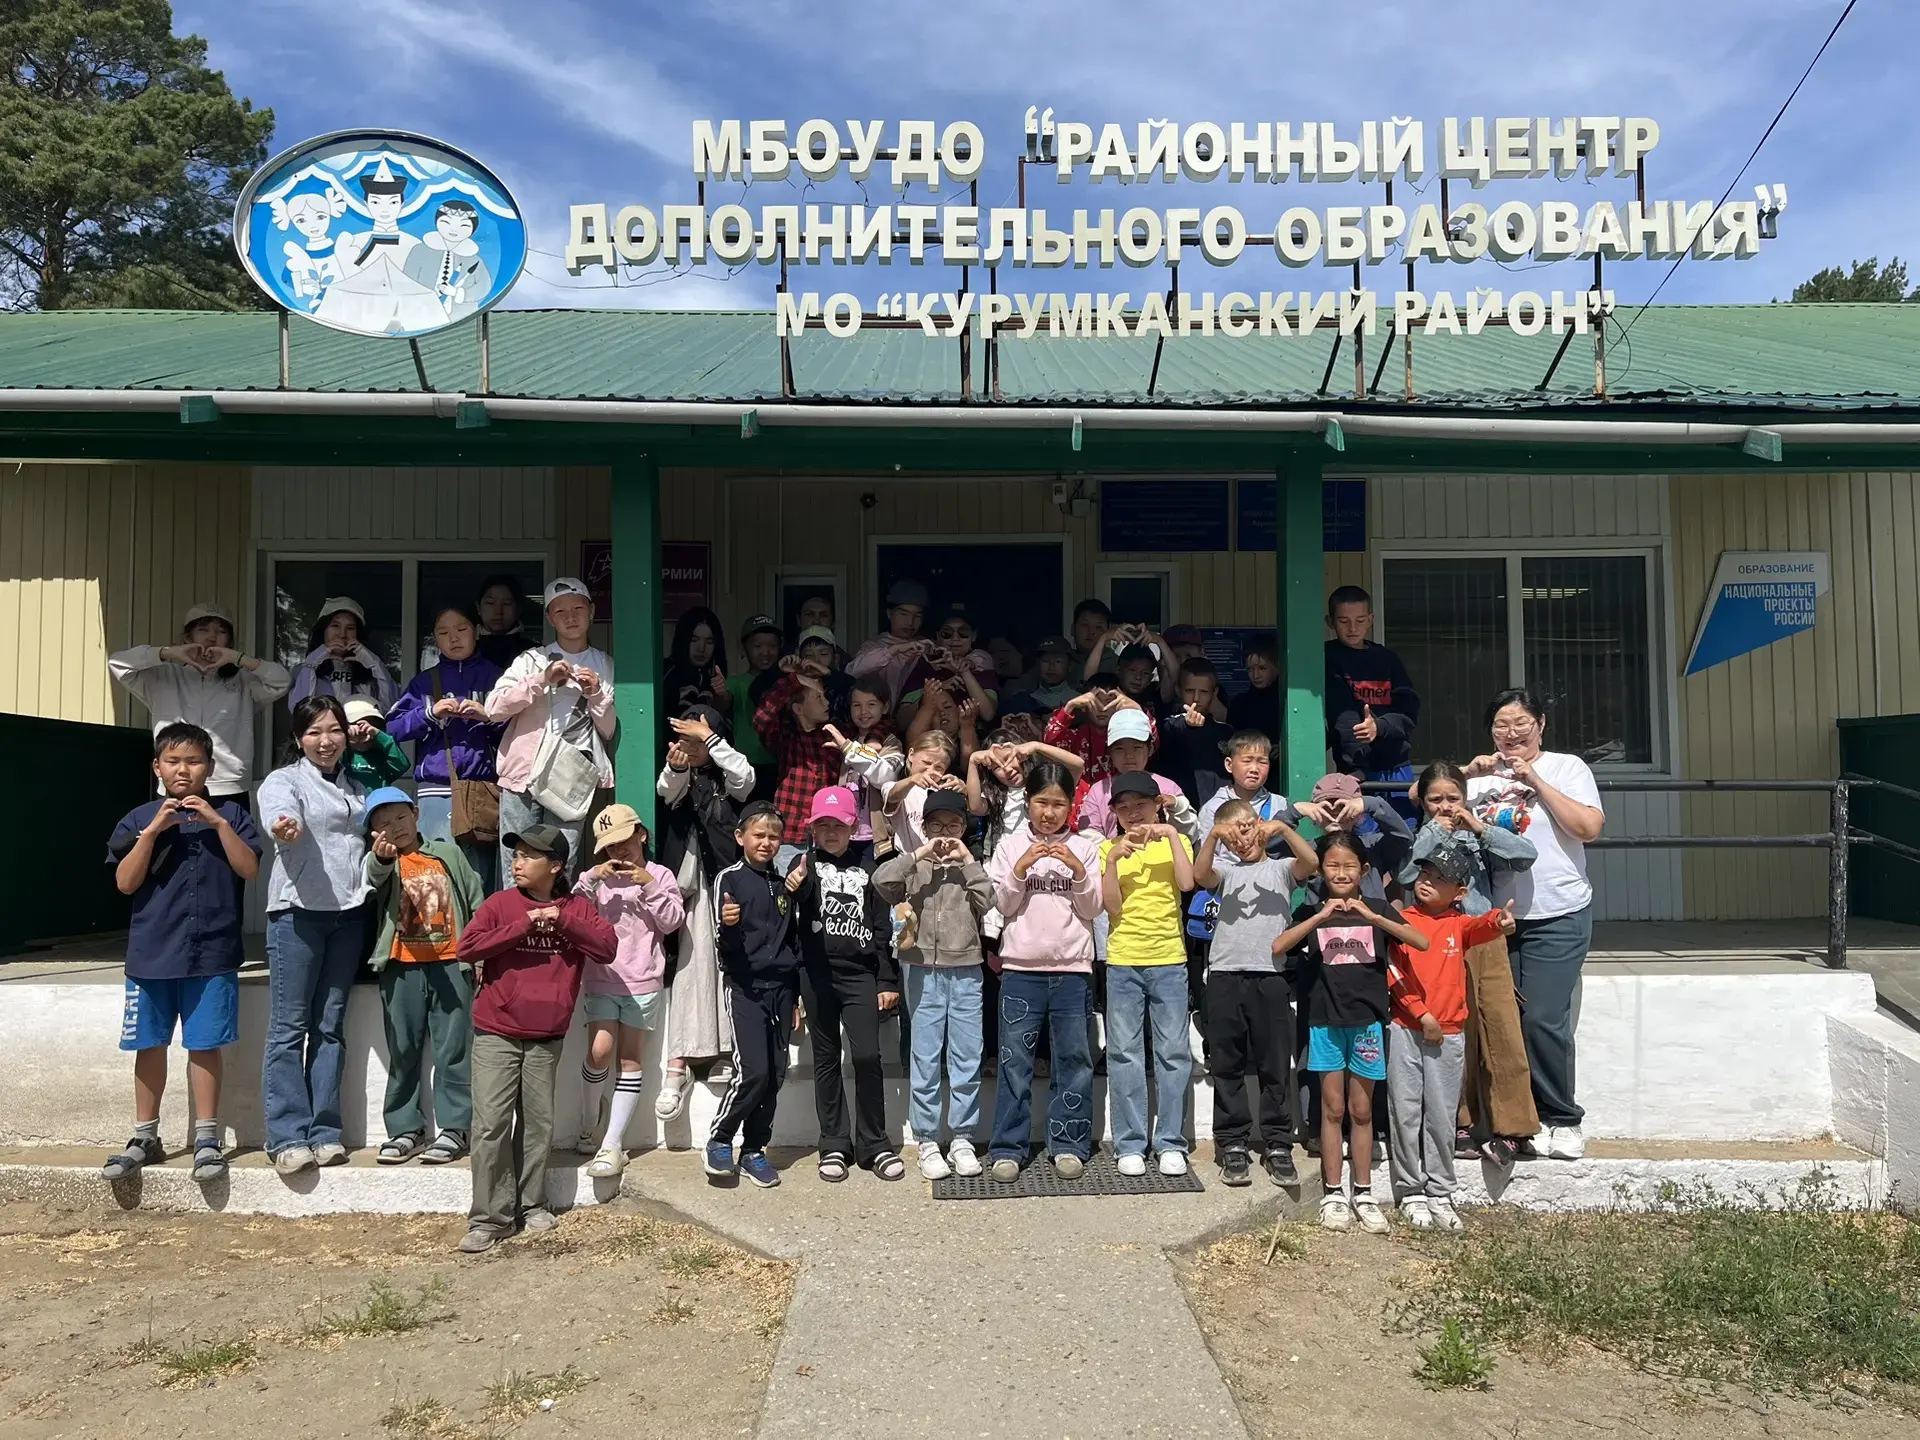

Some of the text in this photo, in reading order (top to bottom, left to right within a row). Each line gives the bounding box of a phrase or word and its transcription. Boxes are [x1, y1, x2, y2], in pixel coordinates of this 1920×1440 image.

[1438, 116, 1661, 190] ЦЕНТР
[564, 202, 1247, 277] ДОПОЛНИТЕЛЬНОГО
[775, 292, 862, 338] МО
[661, 568, 703, 580] РМИИ
[1737, 563, 1815, 574] ОБРАЗОВАНИЕ
[1724, 583, 1814, 599] НАЦИОНАЛЬНЫЕ
[1764, 598, 1815, 611] ПРОЕКТЫ
[1774, 612, 1815, 625] РОССИИ
[825, 916, 873, 948] kidlife
[526, 936, 554, 948] WAY
[1325, 941, 1370, 950] PERFECTLY
[121, 985, 140, 1041] REAL
